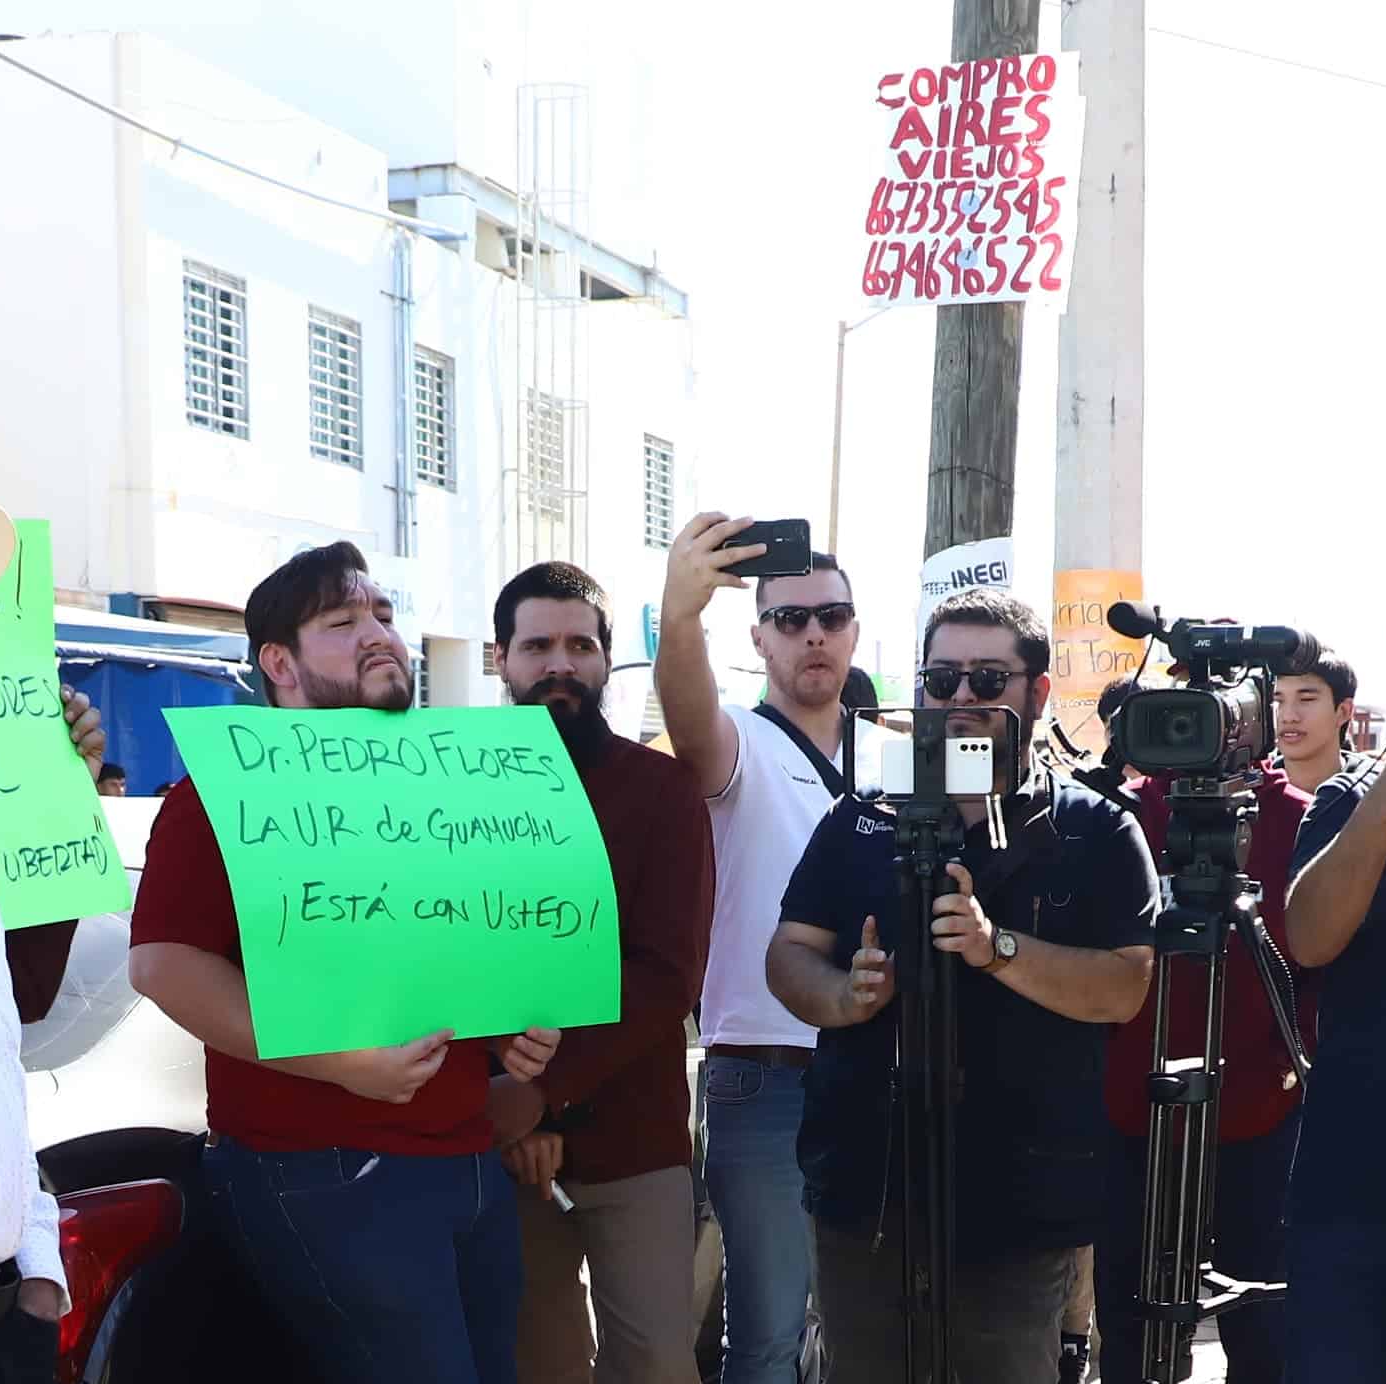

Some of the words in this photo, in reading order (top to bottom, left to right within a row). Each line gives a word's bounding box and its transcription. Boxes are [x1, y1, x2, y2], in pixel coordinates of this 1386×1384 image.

[876, 54, 1056, 109] COMPRO
[890, 94, 1050, 149] AIRES
[897, 144, 1045, 179] VIEJOS
[951, 560, 1007, 588] INEGI
[1194, 639, 1211, 648] JVC
[228, 724, 290, 774] Dr.
[291, 723, 427, 777] PEDRO
[429, 730, 565, 792] FLORES
[239, 800, 289, 845] LA
[376, 803, 420, 843] de
